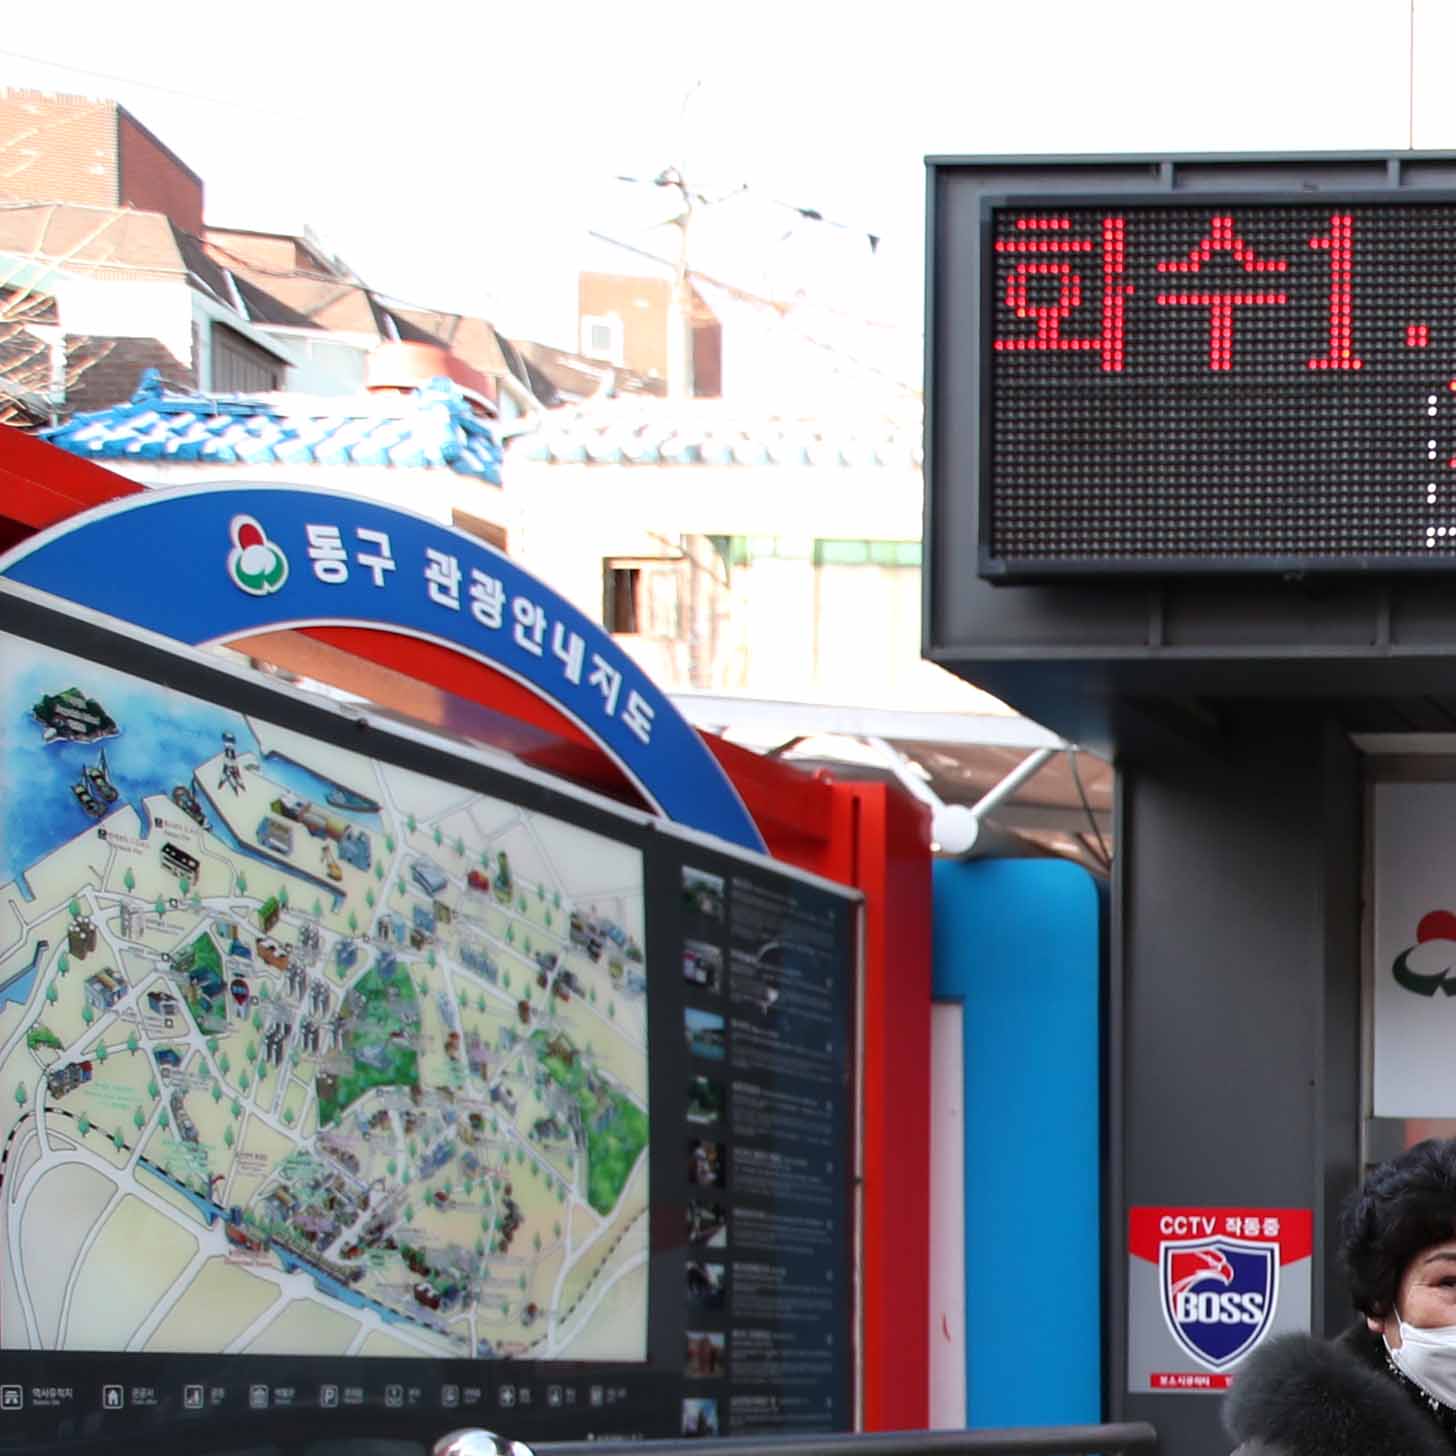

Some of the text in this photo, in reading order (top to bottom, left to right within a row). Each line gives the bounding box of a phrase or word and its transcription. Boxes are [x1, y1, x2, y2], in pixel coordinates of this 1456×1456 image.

[305, 523, 655, 746] 동구 관광안내지도
[1159, 1215, 1281, 1237] CCTV 작동중
[1176, 1291, 1264, 1325] BOSS
